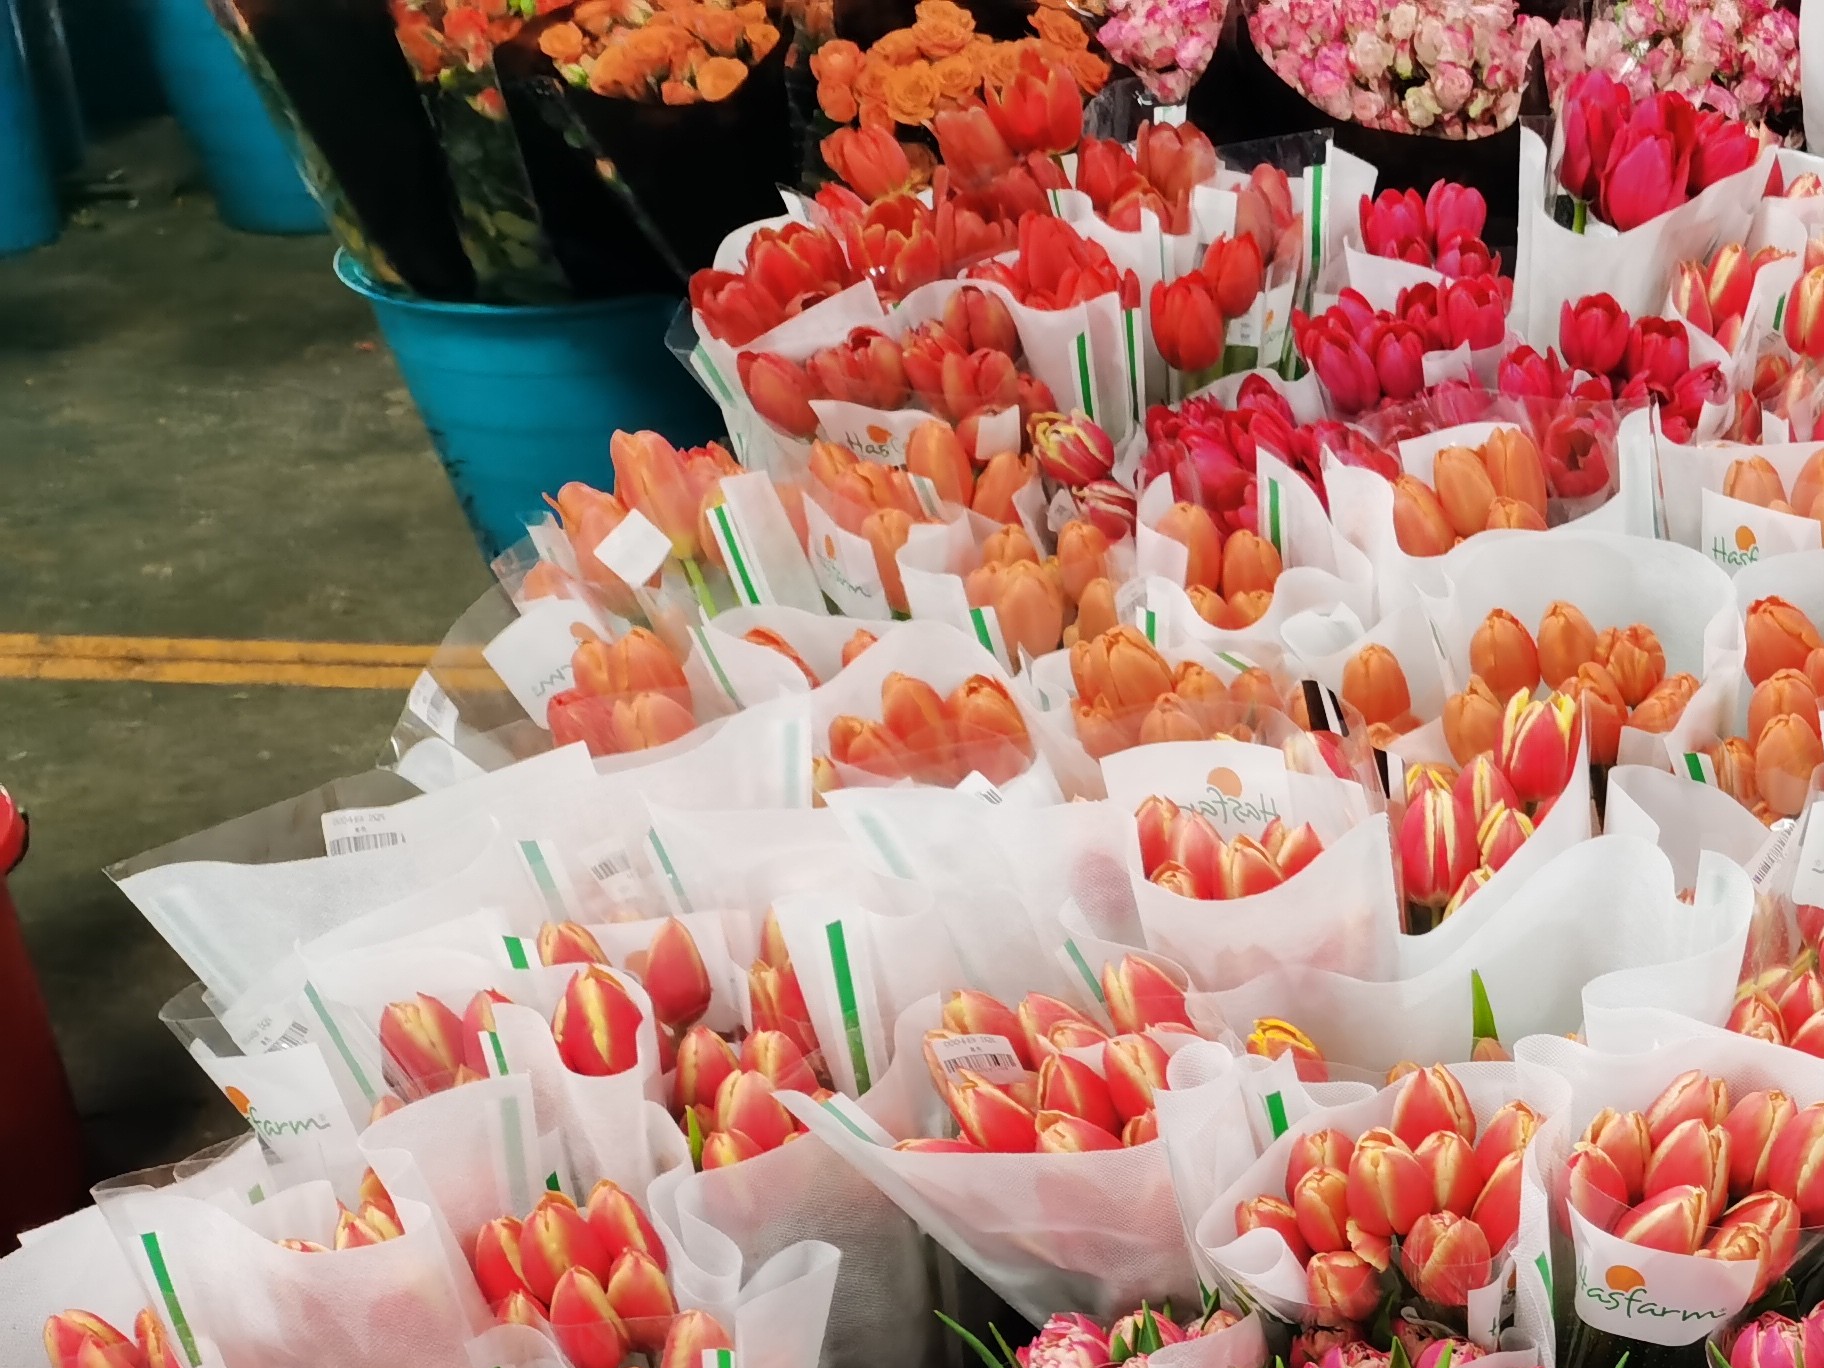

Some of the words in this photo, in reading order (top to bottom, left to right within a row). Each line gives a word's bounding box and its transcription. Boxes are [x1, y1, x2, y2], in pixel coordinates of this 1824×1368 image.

[1712, 535, 1760, 566] Hasf
[247, 1106, 332, 1143] farm
[1578, 1256, 1727, 1322] Hasfarm
